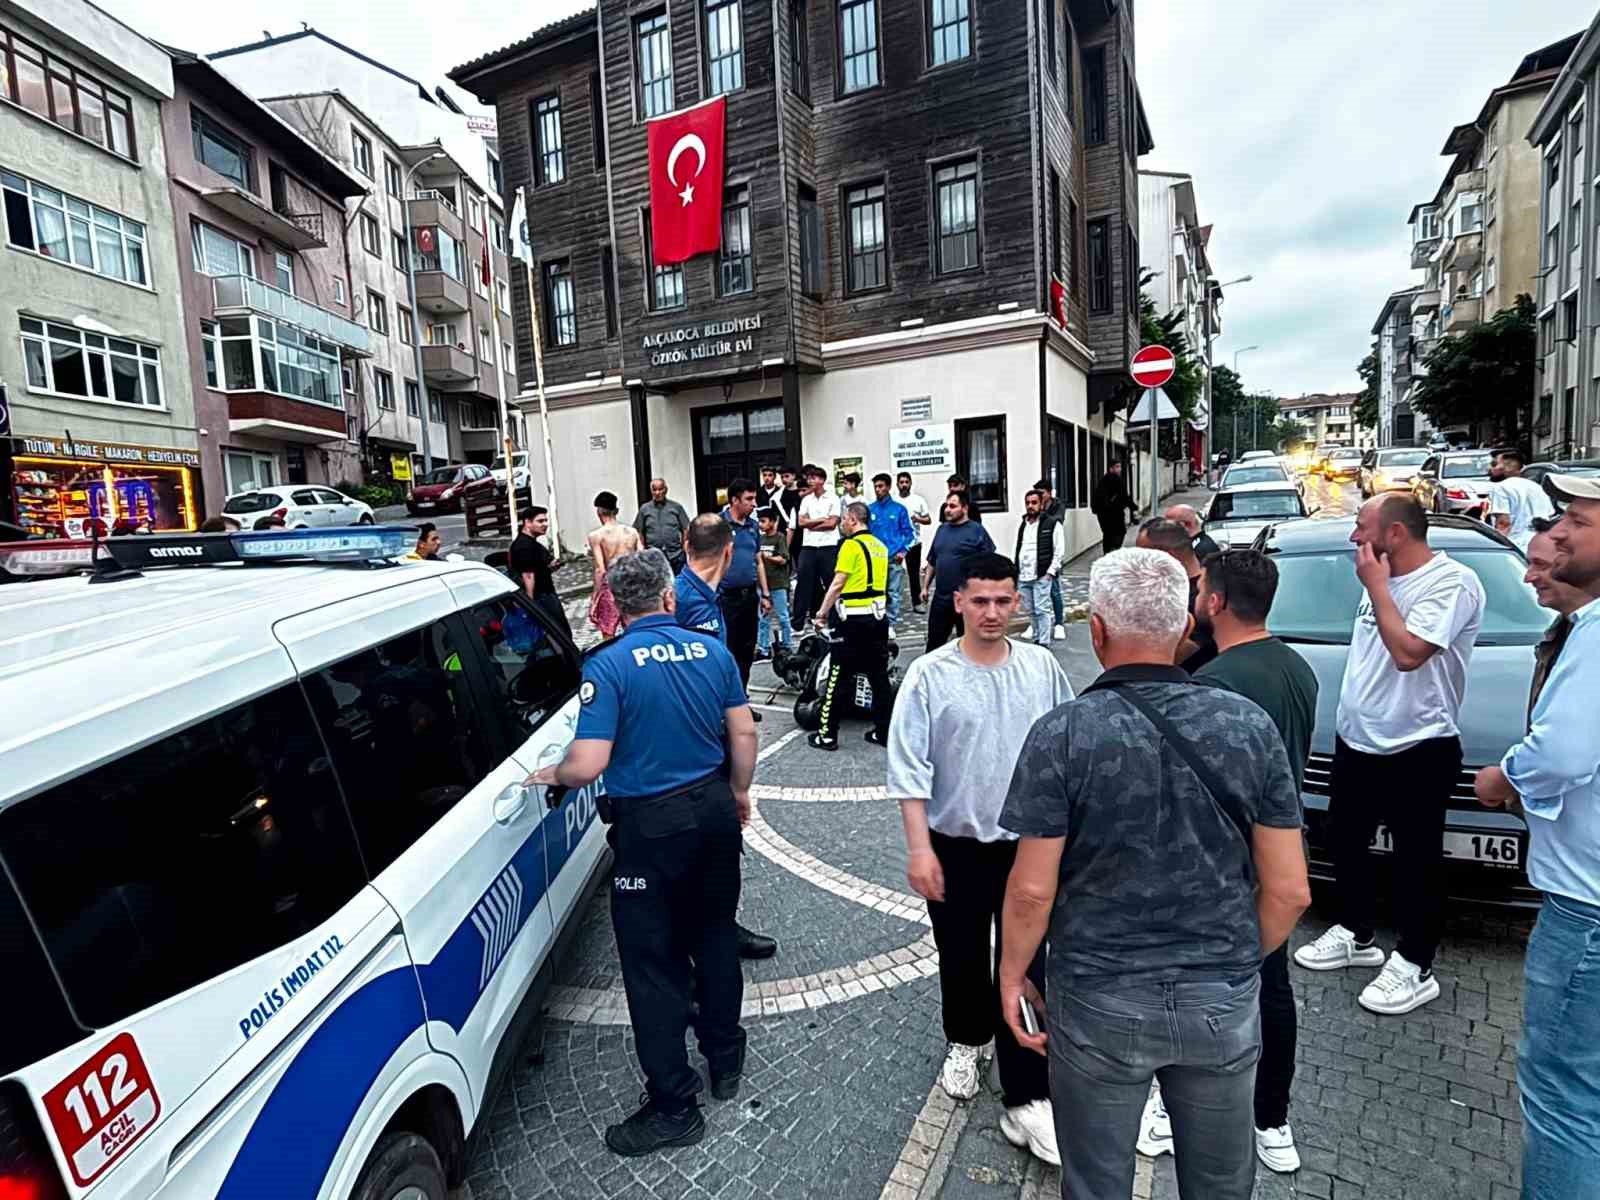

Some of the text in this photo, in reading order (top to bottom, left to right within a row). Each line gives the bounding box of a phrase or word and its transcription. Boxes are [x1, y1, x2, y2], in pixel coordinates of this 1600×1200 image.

[643, 313, 761, 348] AKÇAKOCA BELEDİYESİ
[651, 335, 752, 366] ÖZKÖK KÜLTÜR EVİ
[1471, 836, 1516, 861] 146
[239, 935, 344, 1040] POLİS İMDAT 112
[64, 1053, 138, 1134] 112
